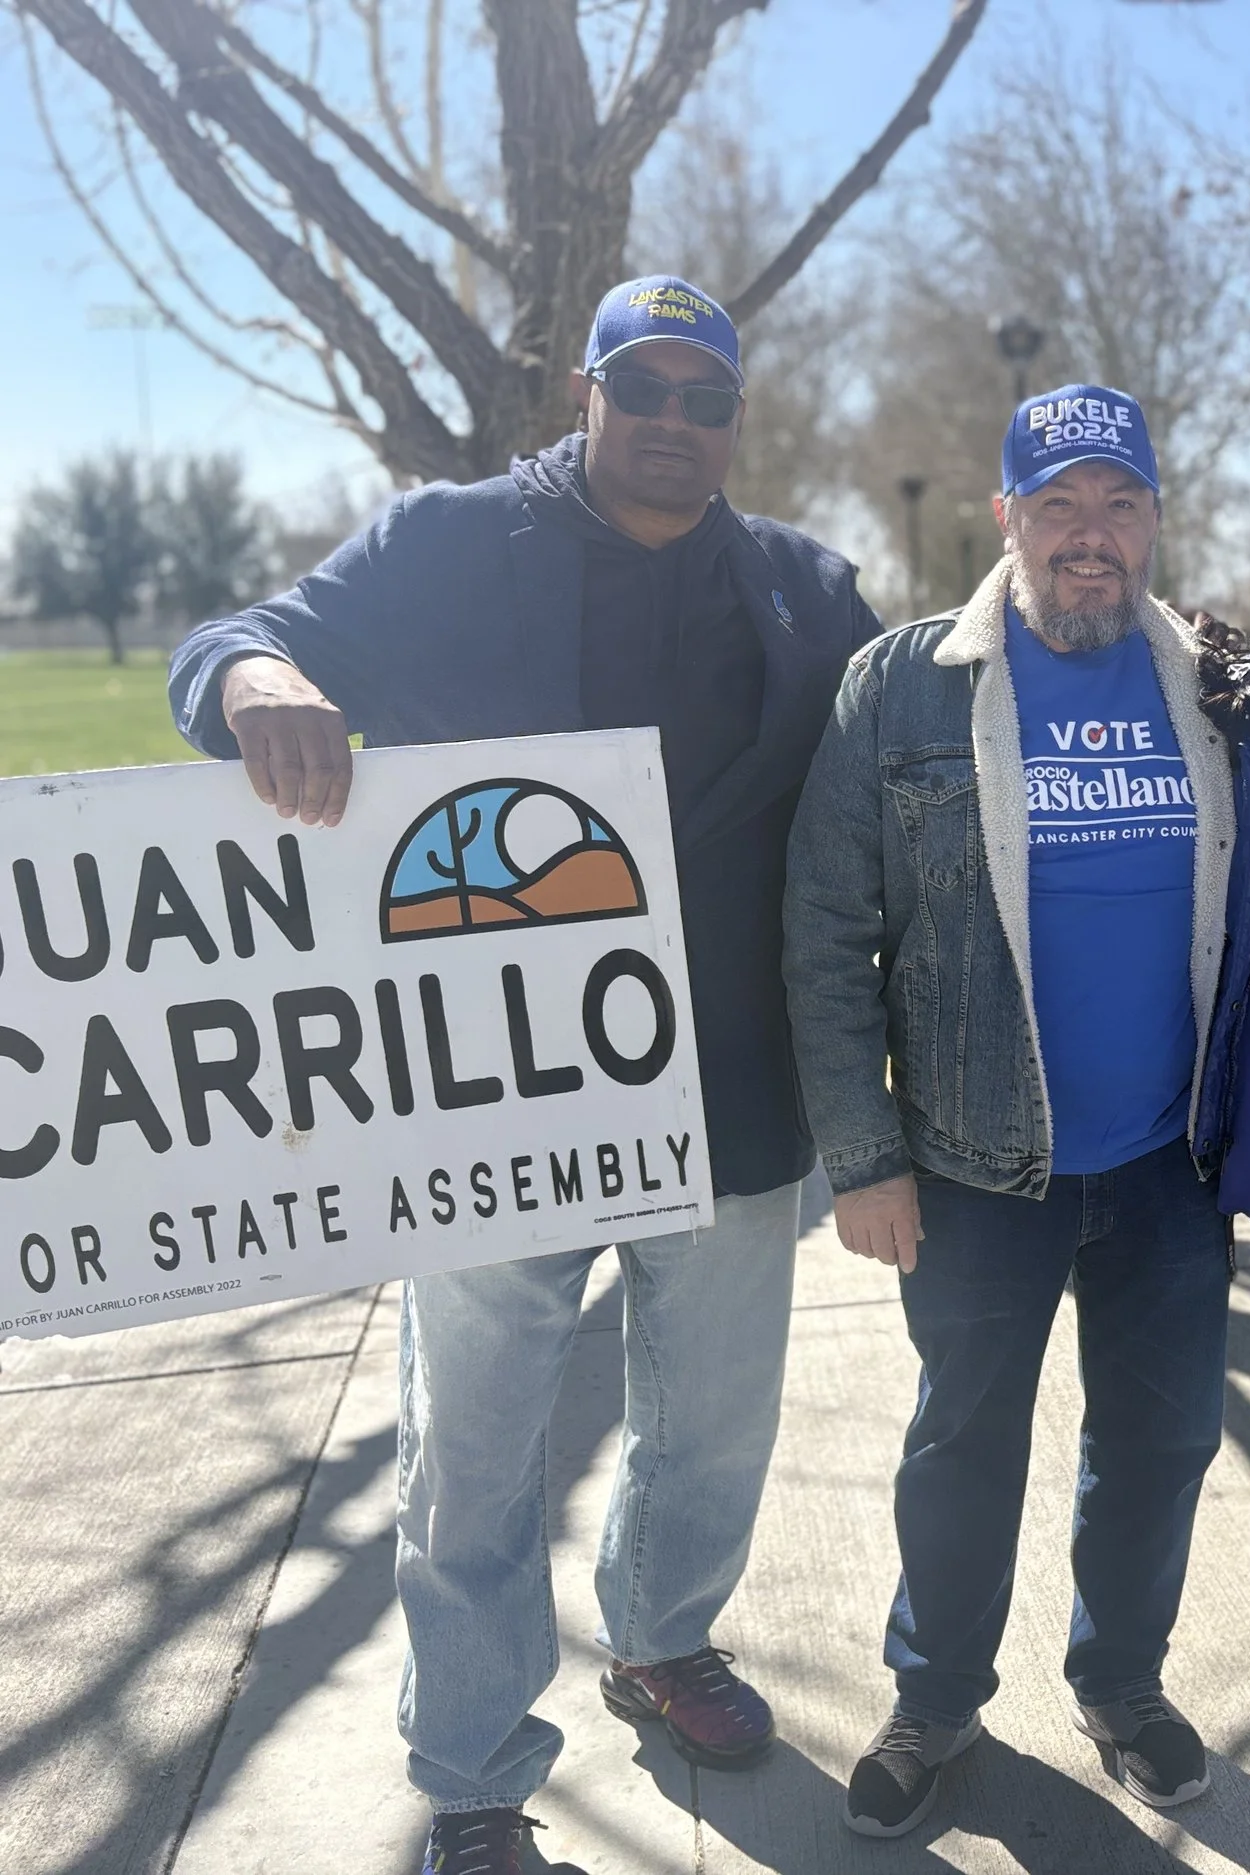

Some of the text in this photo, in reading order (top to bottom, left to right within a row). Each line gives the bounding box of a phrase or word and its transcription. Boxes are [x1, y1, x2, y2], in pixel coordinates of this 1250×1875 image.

[628, 287, 714, 318] LANCASTER
[647, 304, 697, 324] RAMS
[1029, 397, 1133, 431] BUKELE
[1045, 422, 1121, 445] 2024
[1047, 720, 1154, 751] VOTE
[1024, 766, 1071, 780] ROCIO
[1028, 829, 1116, 844] LANCASTER
[1122, 827, 1155, 839] CITY
[0, 833, 315, 982] UAN
[149, 1184, 347, 1271] STATE
[390, 1132, 690, 1233] ASSEMBLY
[16, 1315, 38, 1328] FOR
[40, 1312, 53, 1324] BY
[55, 1306, 84, 1320] JUAN
[86, 1297, 137, 1314] CARRILLO
[138, 1293, 160, 1305] FOR
[162, 1284, 214, 1301] ASSEMBLY
[217, 1279, 242, 1292] 2022
